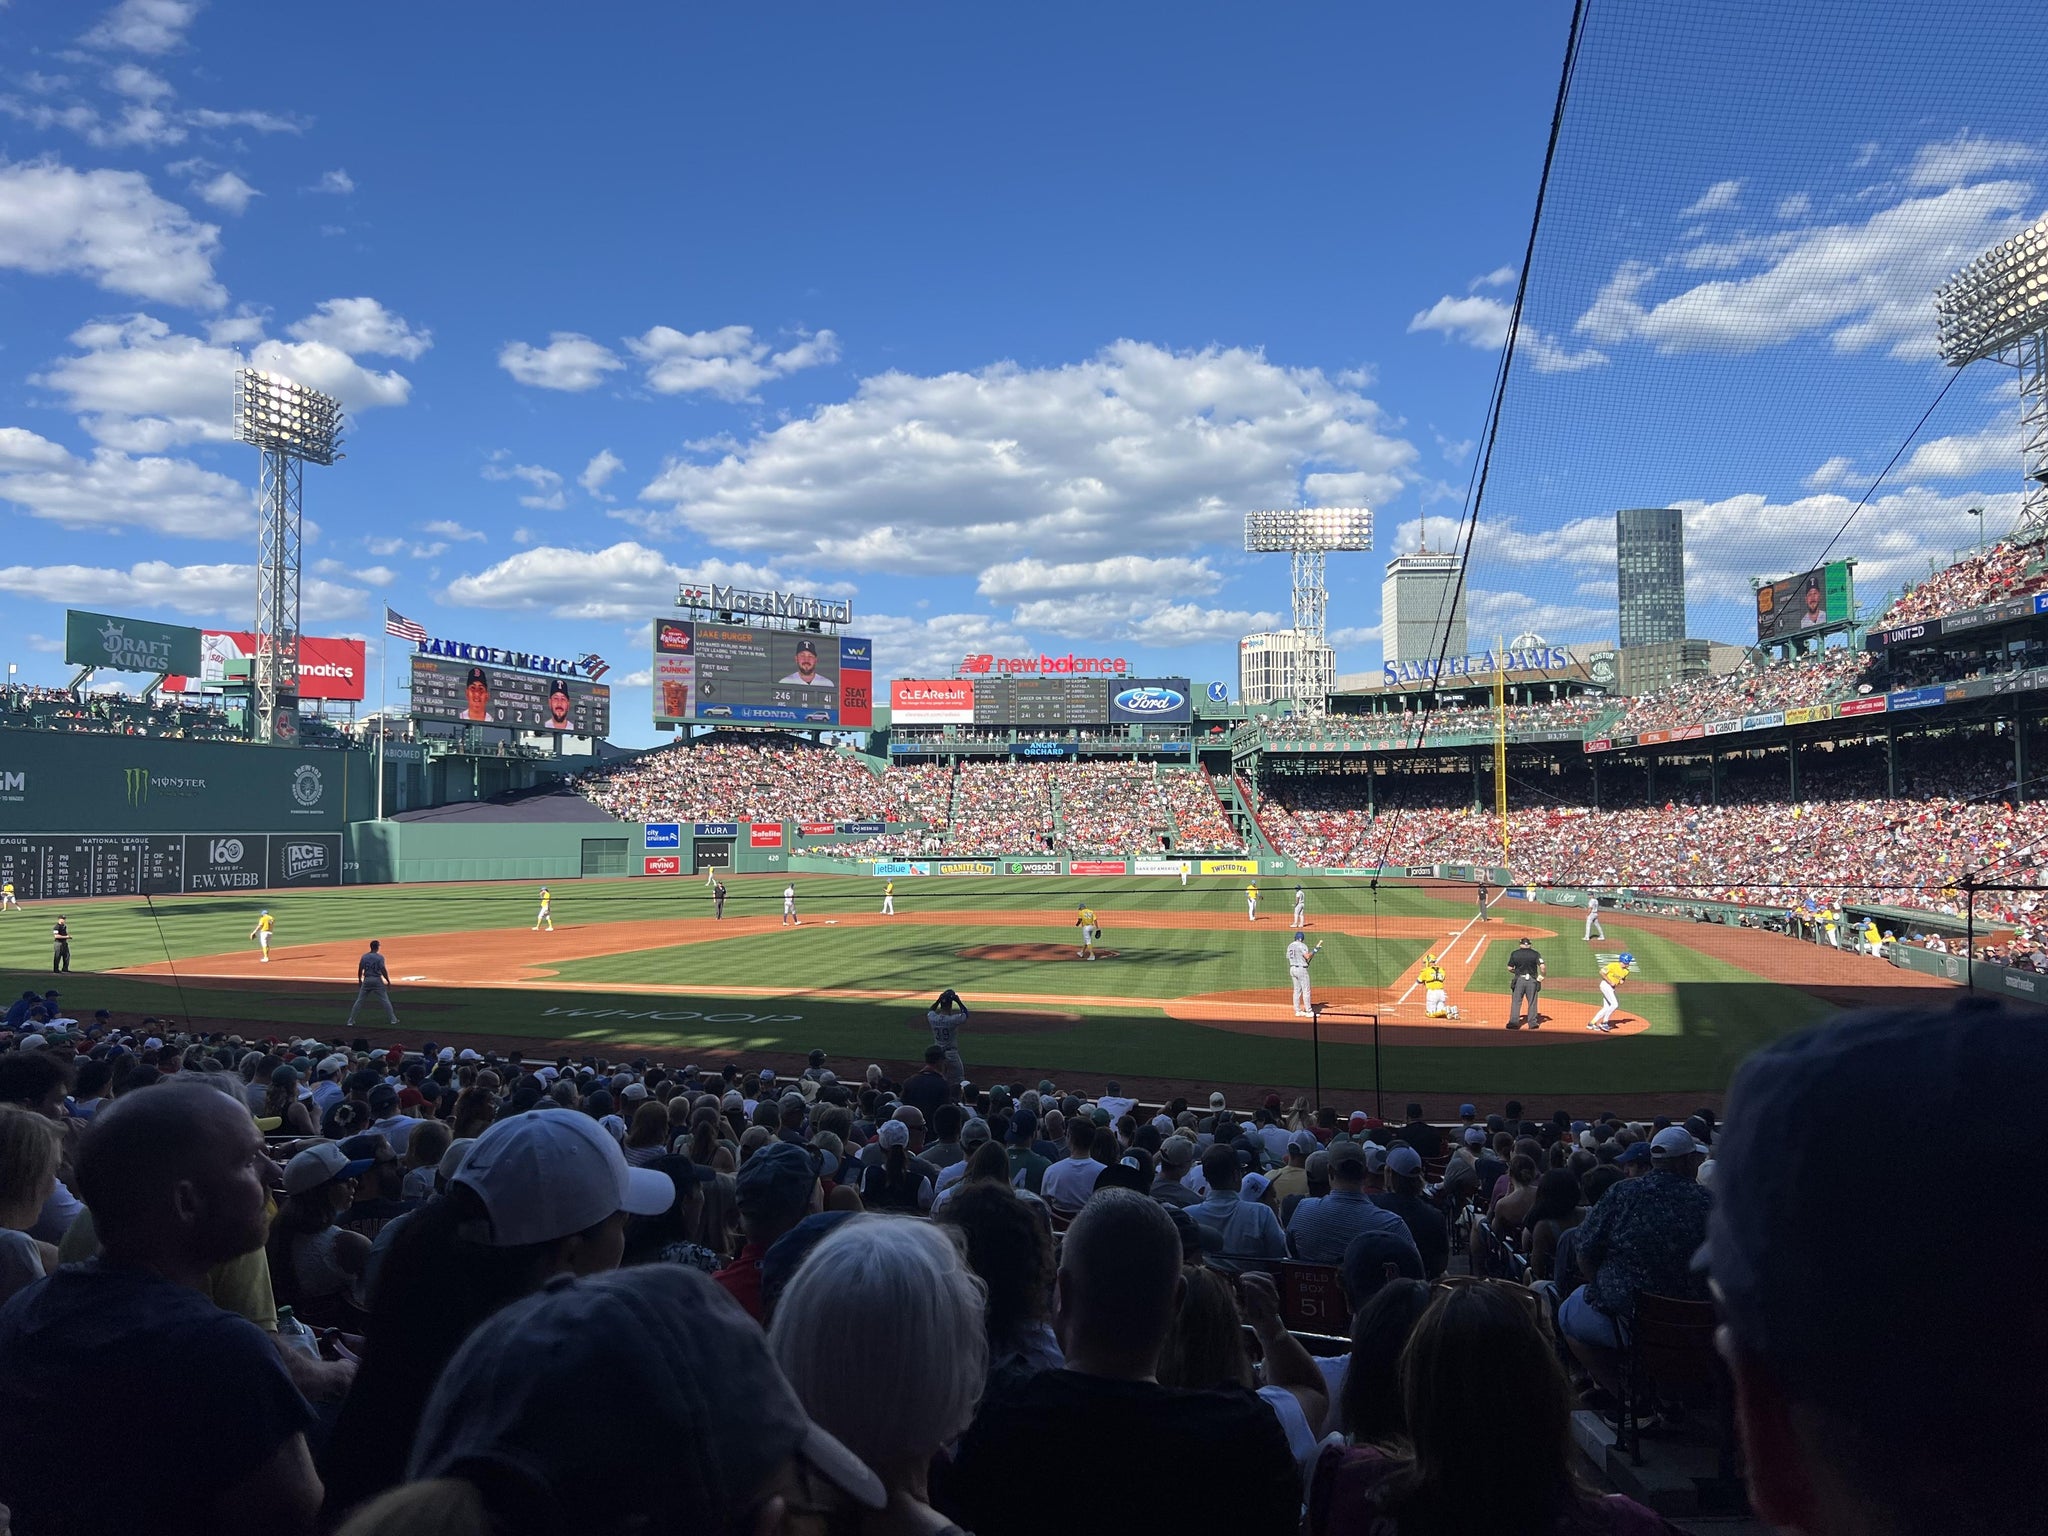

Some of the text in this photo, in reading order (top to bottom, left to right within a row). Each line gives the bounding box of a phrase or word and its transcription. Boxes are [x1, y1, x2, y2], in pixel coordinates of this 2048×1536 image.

[710, 583, 852, 624] MassMutual
[698, 630, 752, 642] JAKE BURGER
[1892, 626, 1924, 642] UNITED
[102, 635, 172, 656] DRAFT
[110, 650, 169, 670] KINGS
[418, 638, 578, 676] BANK OF AMERICA
[997, 658, 1038, 672] new
[1040, 652, 1126, 673] balance
[1590, 652, 1614, 662] BOSTON
[290, 663, 353, 678] anatics
[1384, 647, 1568, 687] SAMUEL ADAMS
[704, 685, 710, 694] K
[846, 688, 866, 698] SEAT
[899, 690, 966, 700] CLEAResult
[773, 692, 790, 700] .246
[824, 694, 832, 702] 41
[844, 698, 867, 708] GEEK
[1128, 692, 1170, 708] Ford
[498, 709, 540, 724] 0 2 0
[752, 710, 797, 720] HONDA
[384, 749, 420, 759] ABIOMED
[210, 839, 244, 864] 160
[291, 845, 324, 861] ACE
[292, 858, 324, 871] TICKET
[650, 862, 674, 870] IRVING
[877, 864, 906, 874] jetBlue
[941, 864, 994, 874] GRANITE CITY
[1212, 864, 1247, 873] TWISTED TEA
[192, 872, 258, 888] F.W. WEBB
[541, 1007, 803, 1024] WHOOP
[1294, 1272, 1328, 1282] FIELD
[1300, 1284, 1324, 1293] BOX
[1301, 1298, 1326, 1318] 51
